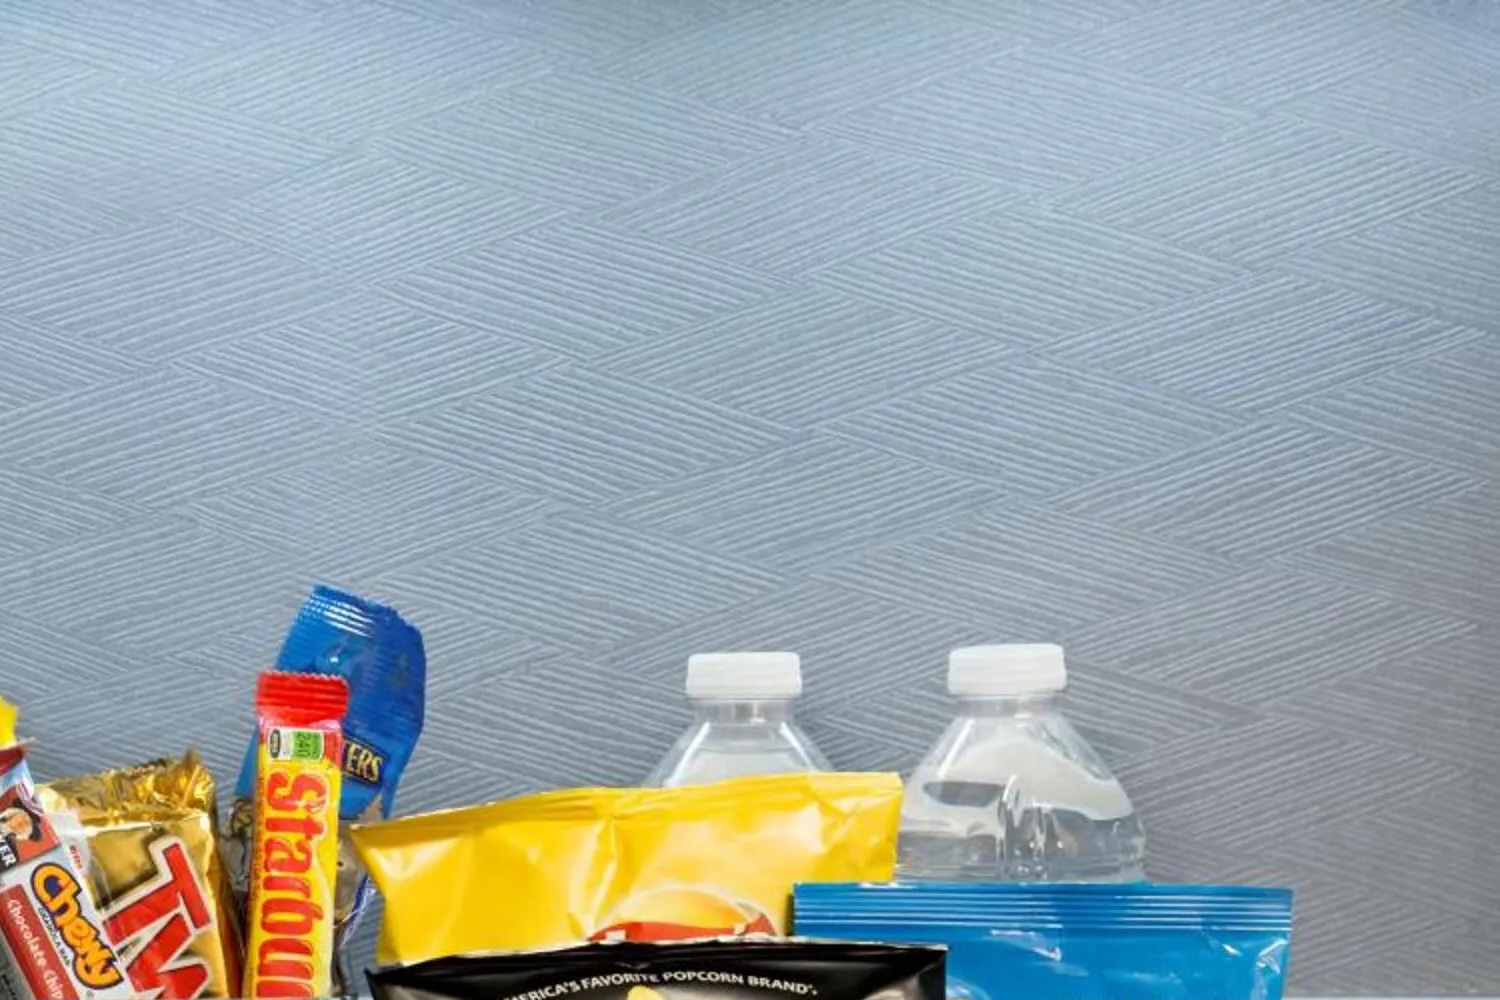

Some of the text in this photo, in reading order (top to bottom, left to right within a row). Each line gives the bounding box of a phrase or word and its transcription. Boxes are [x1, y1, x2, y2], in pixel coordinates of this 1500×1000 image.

[7, 899, 66, 1000] Chocolate Chip
[30, 862, 124, 991] Chewy
[581, 972, 660, 990] FAVORITE
[662, 970, 744, 984] POPCORN
